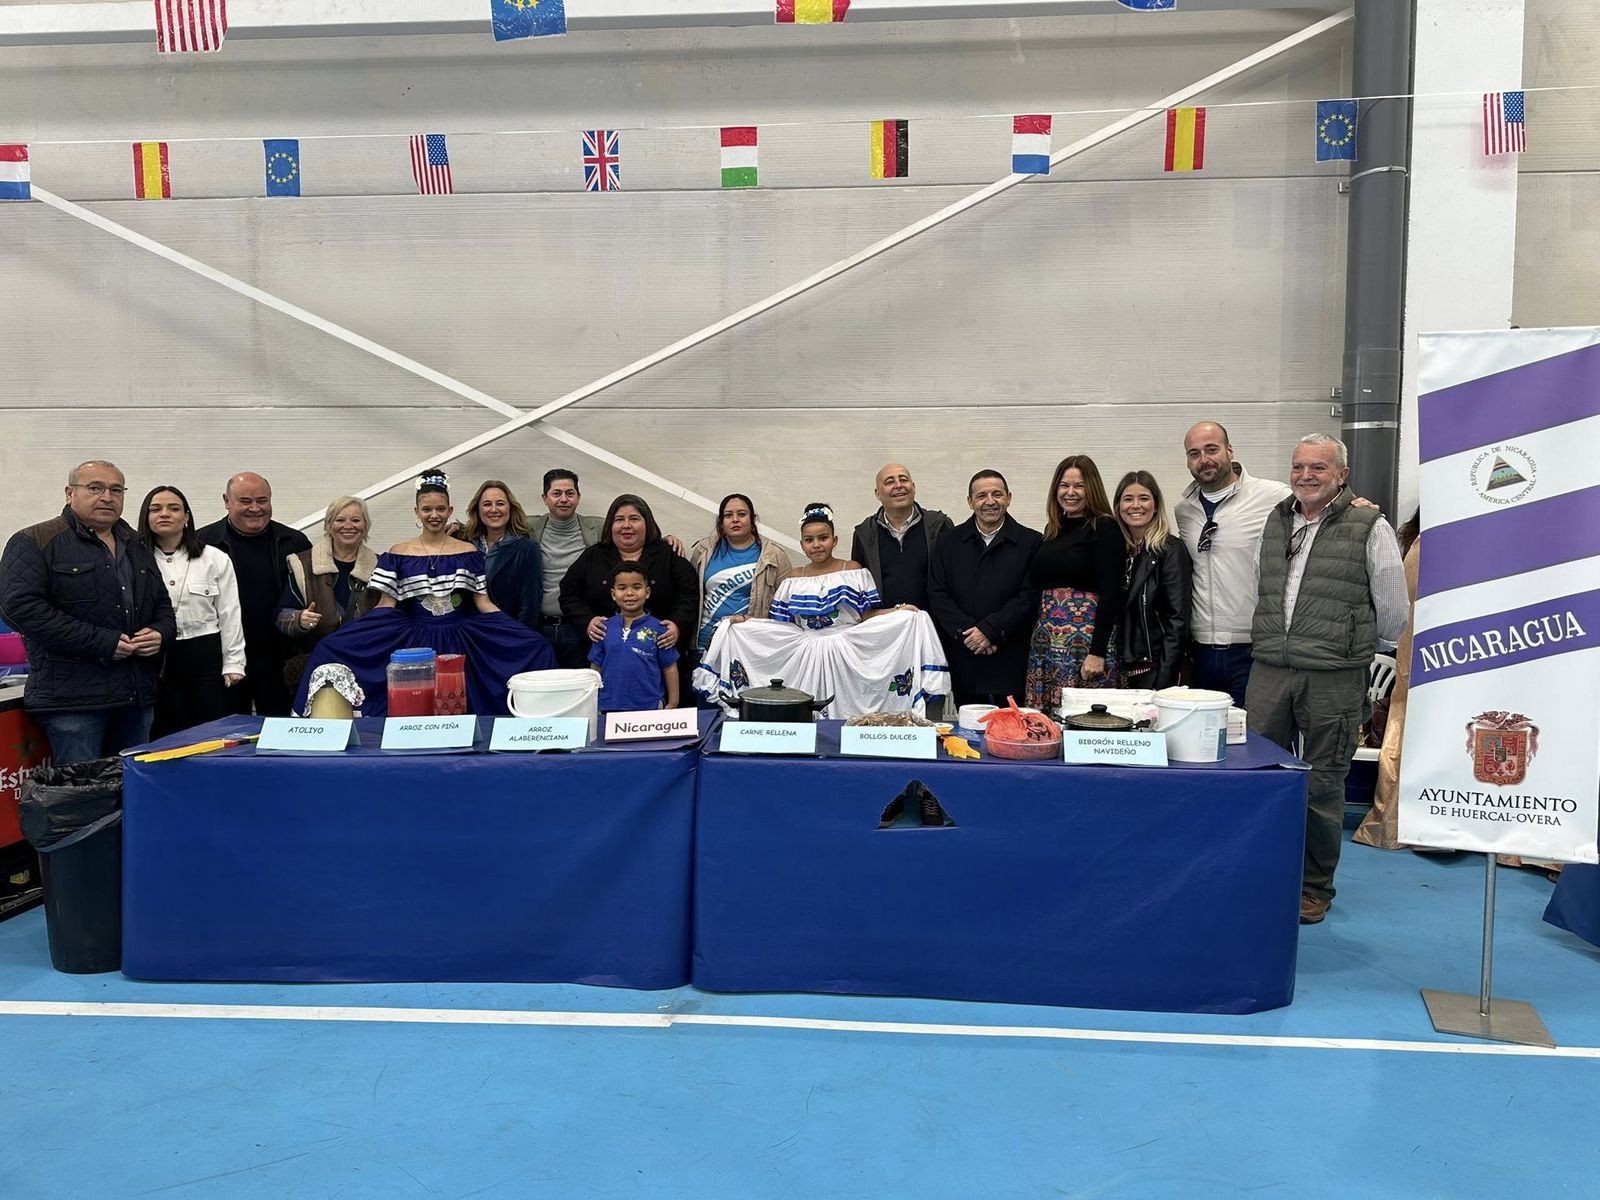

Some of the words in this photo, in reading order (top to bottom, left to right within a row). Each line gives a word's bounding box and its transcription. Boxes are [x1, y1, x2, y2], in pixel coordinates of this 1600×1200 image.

[1505, 445, 1537, 474] NICARAGUA
[1511, 479, 1536, 503] CENTRAL
[1419, 611, 1586, 672] NICARAGUA
[288, 726, 324, 734] ATOLIYO
[441, 722, 459, 730] PIÑA
[614, 719, 688, 735] Nicaragua
[765, 729, 797, 737] RELLENA
[889, 733, 918, 741] DULCES
[1078, 737, 1115, 746] BIBORÓN
[1116, 739, 1151, 748] RELLENO
[1093, 746, 1137, 756] NAVIDEÑO
[1418, 788, 1578, 813] AYUNTAMIENTO
[1430, 805, 1447, 816] DE
[1451, 807, 1562, 826] HUERCAL-OVERA
